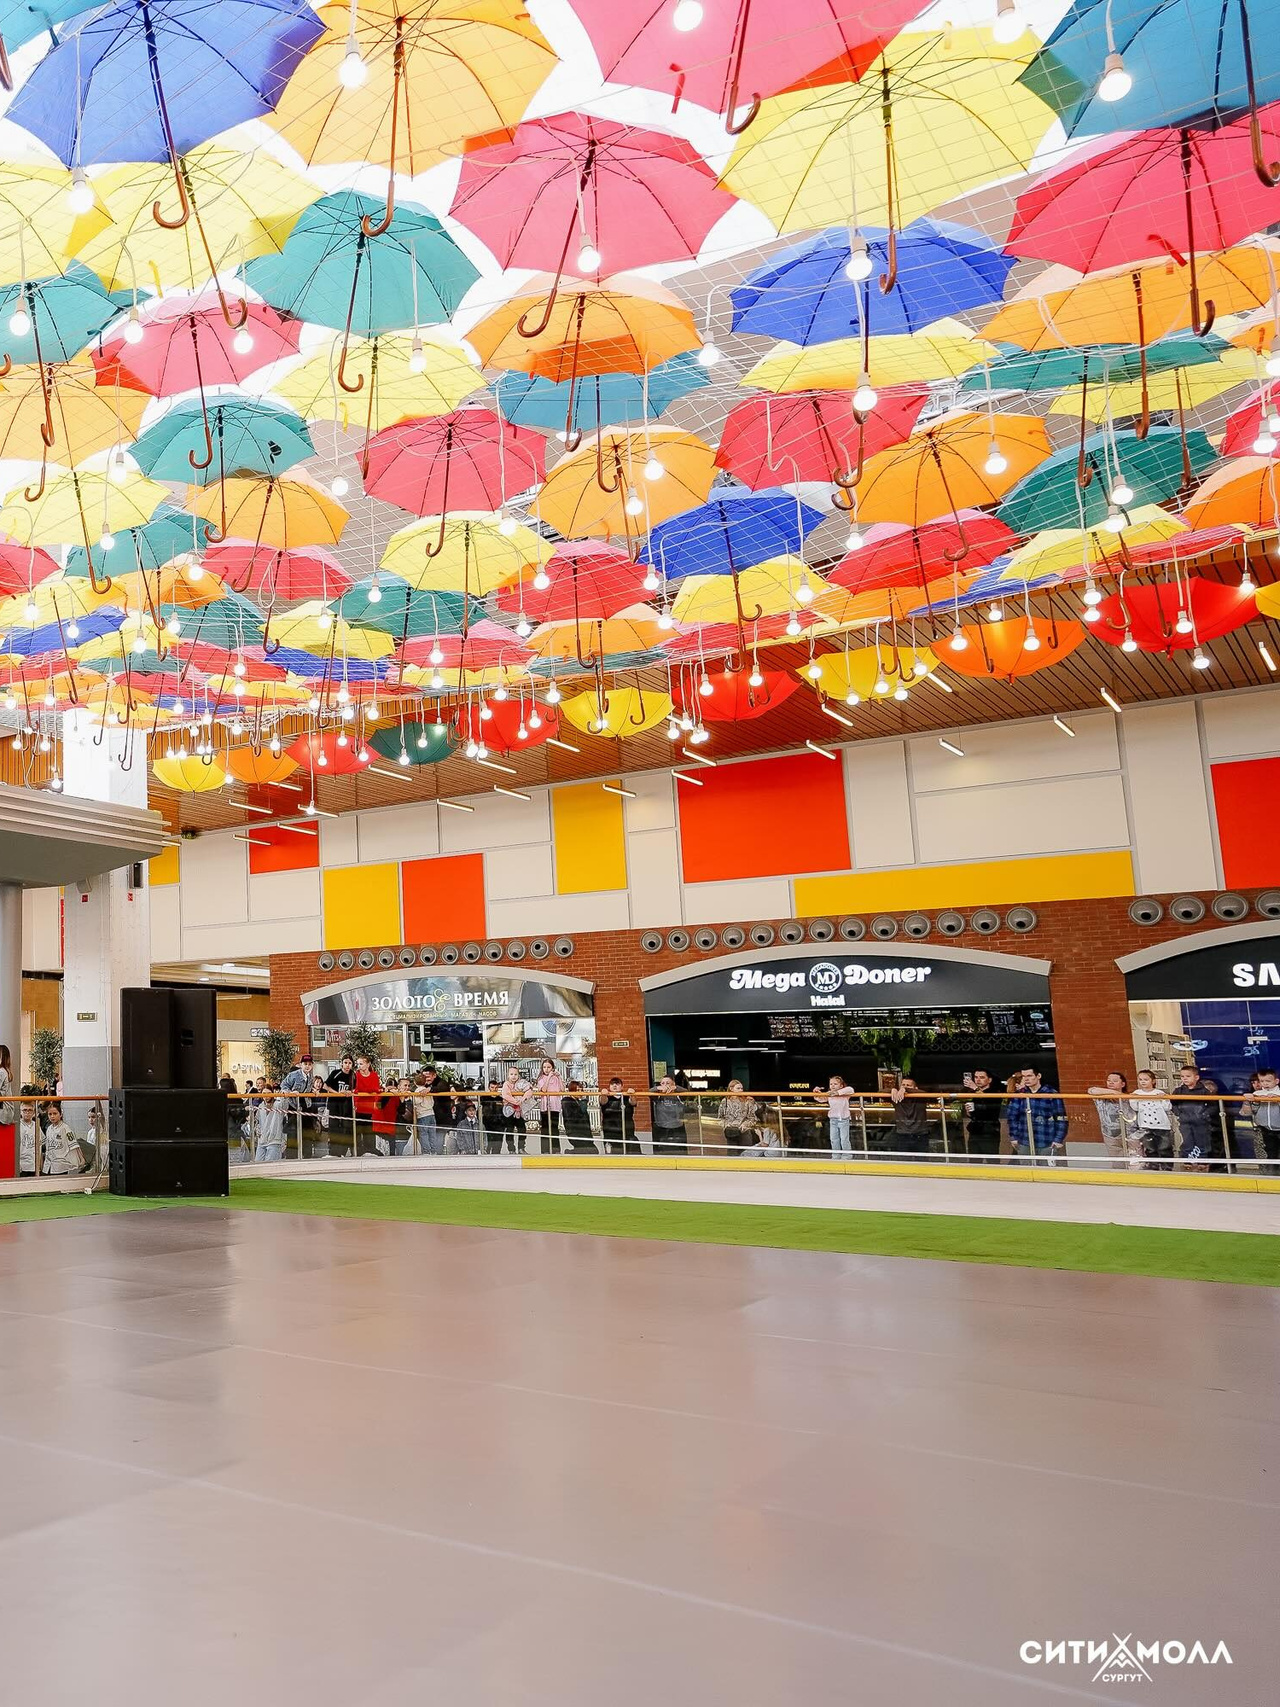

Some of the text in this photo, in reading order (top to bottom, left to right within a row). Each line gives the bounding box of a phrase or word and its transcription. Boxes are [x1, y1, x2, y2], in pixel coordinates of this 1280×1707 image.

[729, 964, 932, 993] Mega Doner
[816, 971, 837, 985] MD
[453, 990, 509, 1007] ВРЕМЯ
[810, 994, 846, 1006] Halal
